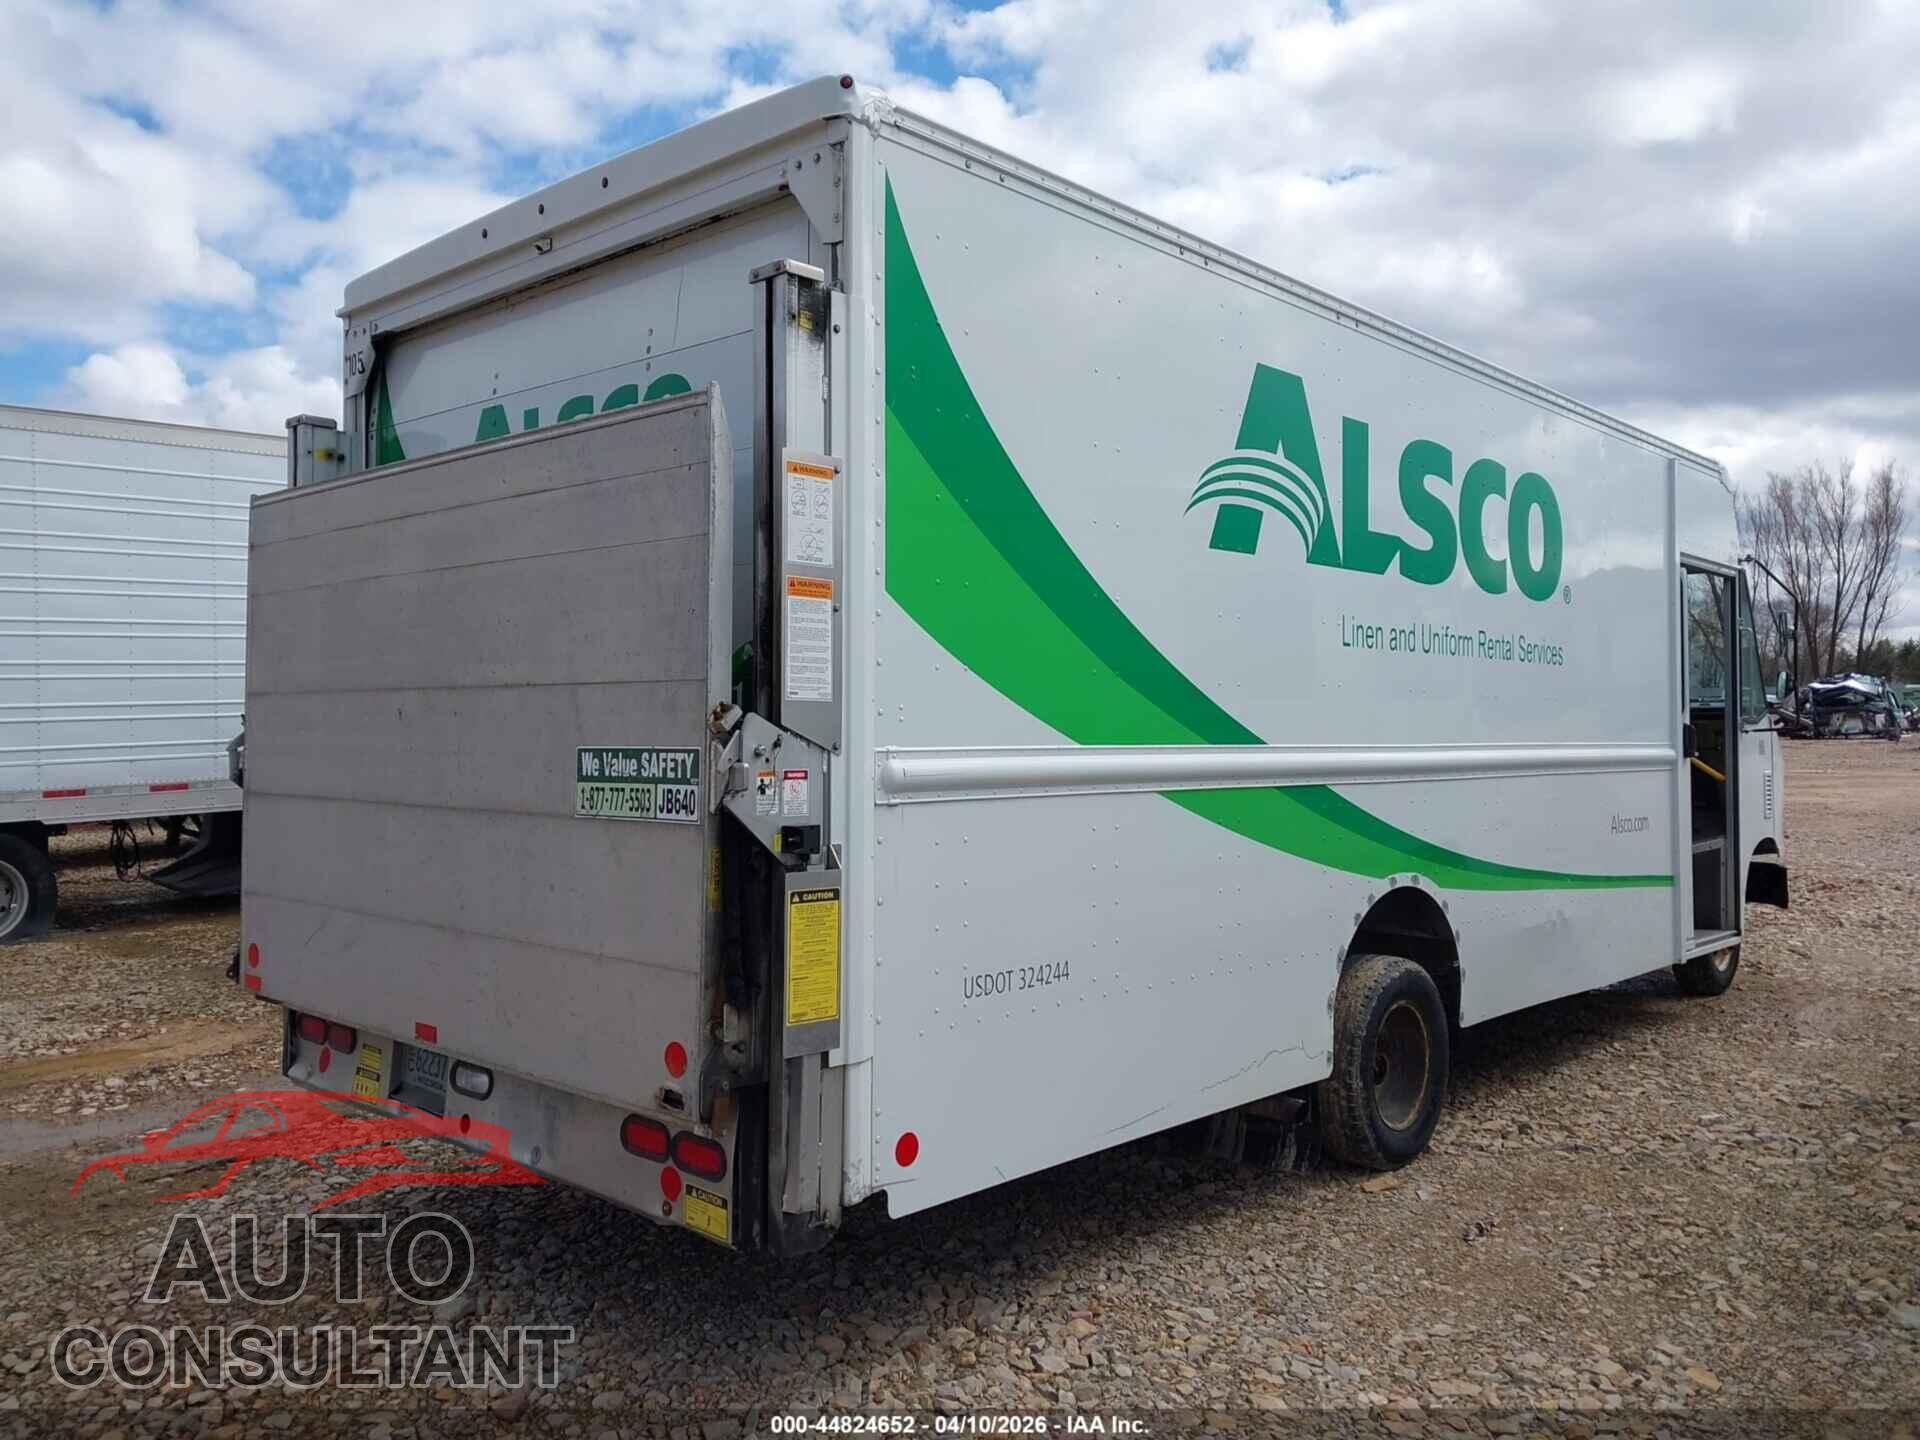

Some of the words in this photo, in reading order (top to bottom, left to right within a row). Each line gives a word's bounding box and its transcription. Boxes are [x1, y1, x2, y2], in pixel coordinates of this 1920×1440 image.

[1183, 362, 1563, 602] ALSCO
[797, 580, 831, 592] WARNING
[1342, 614, 1384, 649] Linen
[1389, 623, 1416, 652] and
[1422, 623, 1474, 658] Uniform
[1478, 630, 1515, 661] Rental
[1518, 635, 1564, 667] Services
[581, 752, 599, 776] We
[603, 752, 638, 777] Value
[641, 752, 694, 779] SAFETY
[580, 786, 652, 813] 1-877-777-5503
[659, 788, 696, 816] JB640
[1611, 813, 1649, 835] Alsco.com
[802, 892, 834, 901] CAUTION
[964, 970, 1014, 999] USDOT
[1018, 960, 1070, 990] 324244
